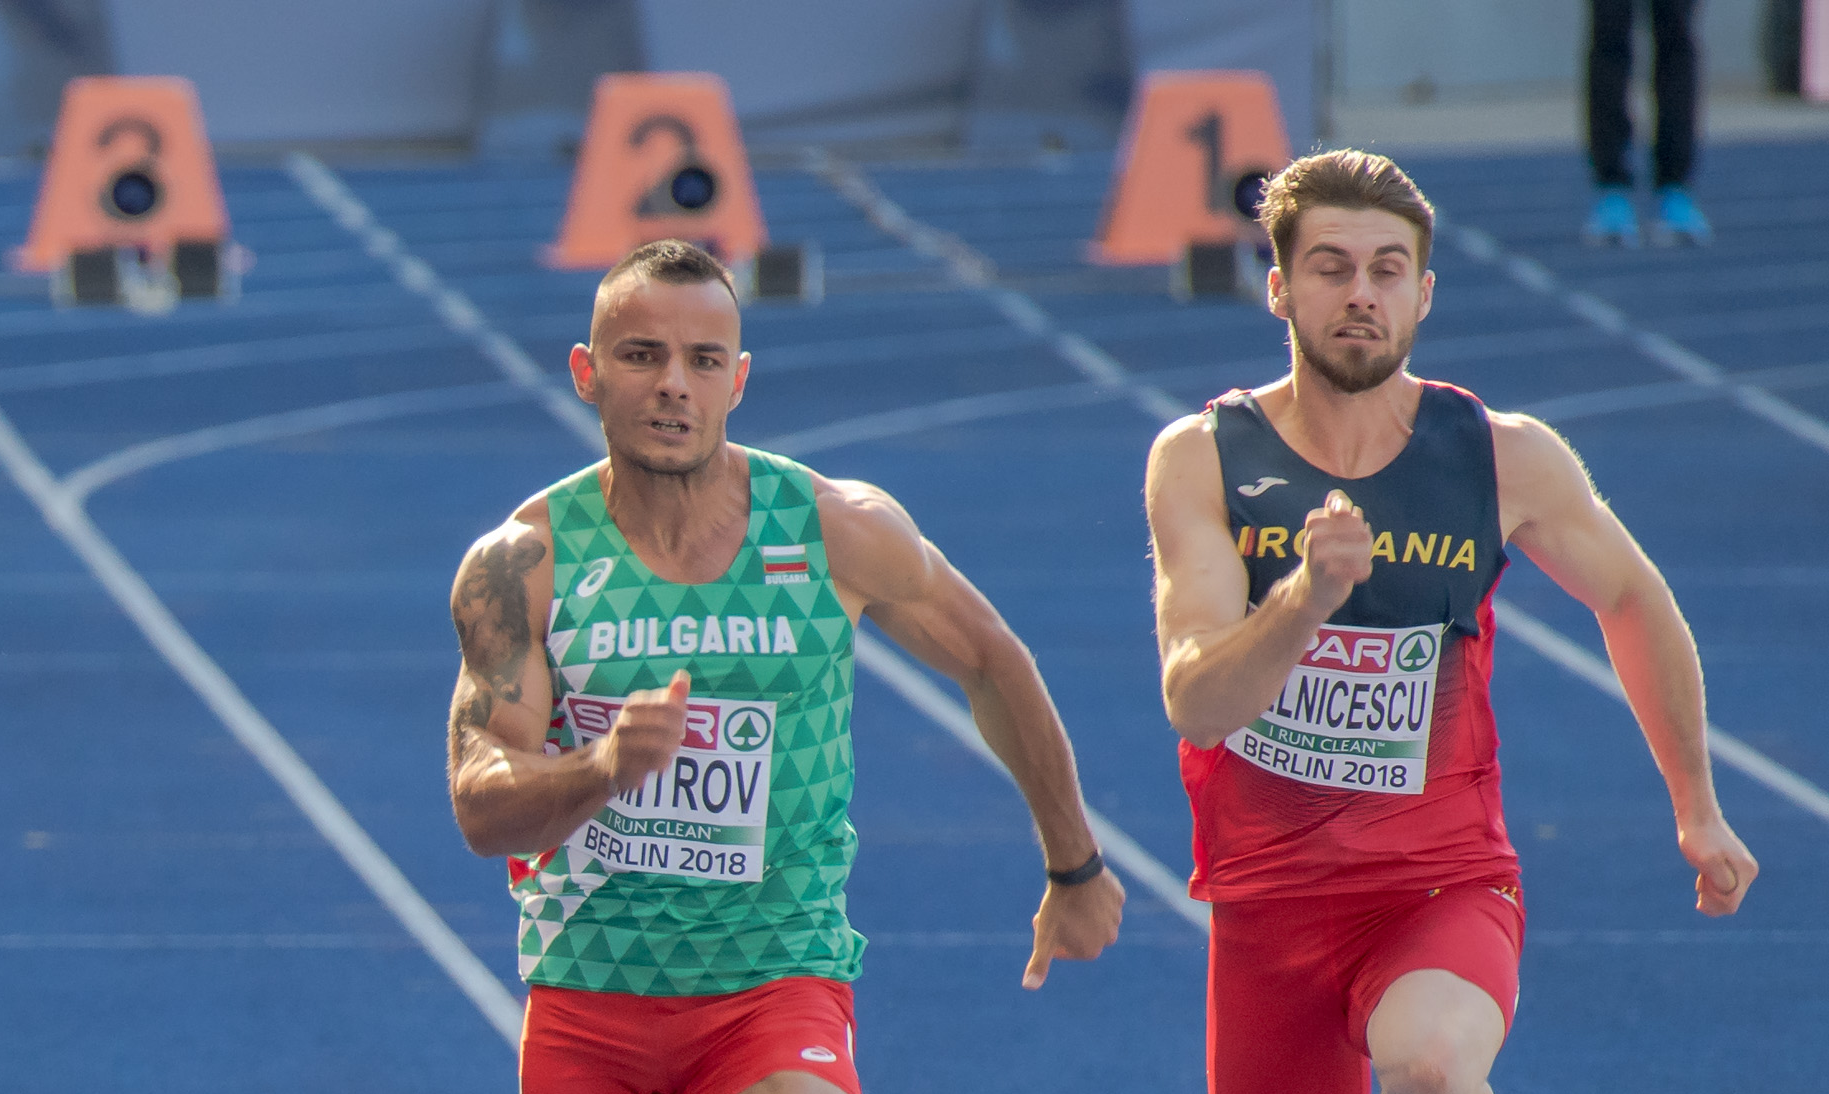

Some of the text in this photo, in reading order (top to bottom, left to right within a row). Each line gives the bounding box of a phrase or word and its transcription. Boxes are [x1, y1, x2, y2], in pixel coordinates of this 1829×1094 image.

[1182, 112, 1228, 212] 1
[589, 615, 798, 660] BULGARIA
[1306, 635, 1389, 668] AR
[575, 703, 716, 744] SR
[1270, 675, 1428, 731] LNICESCU
[1269, 725, 1274, 737] I
[1278, 729, 1315, 748] RUN
[1243, 733, 1408, 788] BERLIN 2018
[607, 813, 612, 825] I
[614, 817, 648, 834] RUN
[584, 824, 747, 876] BERLIN 2018
